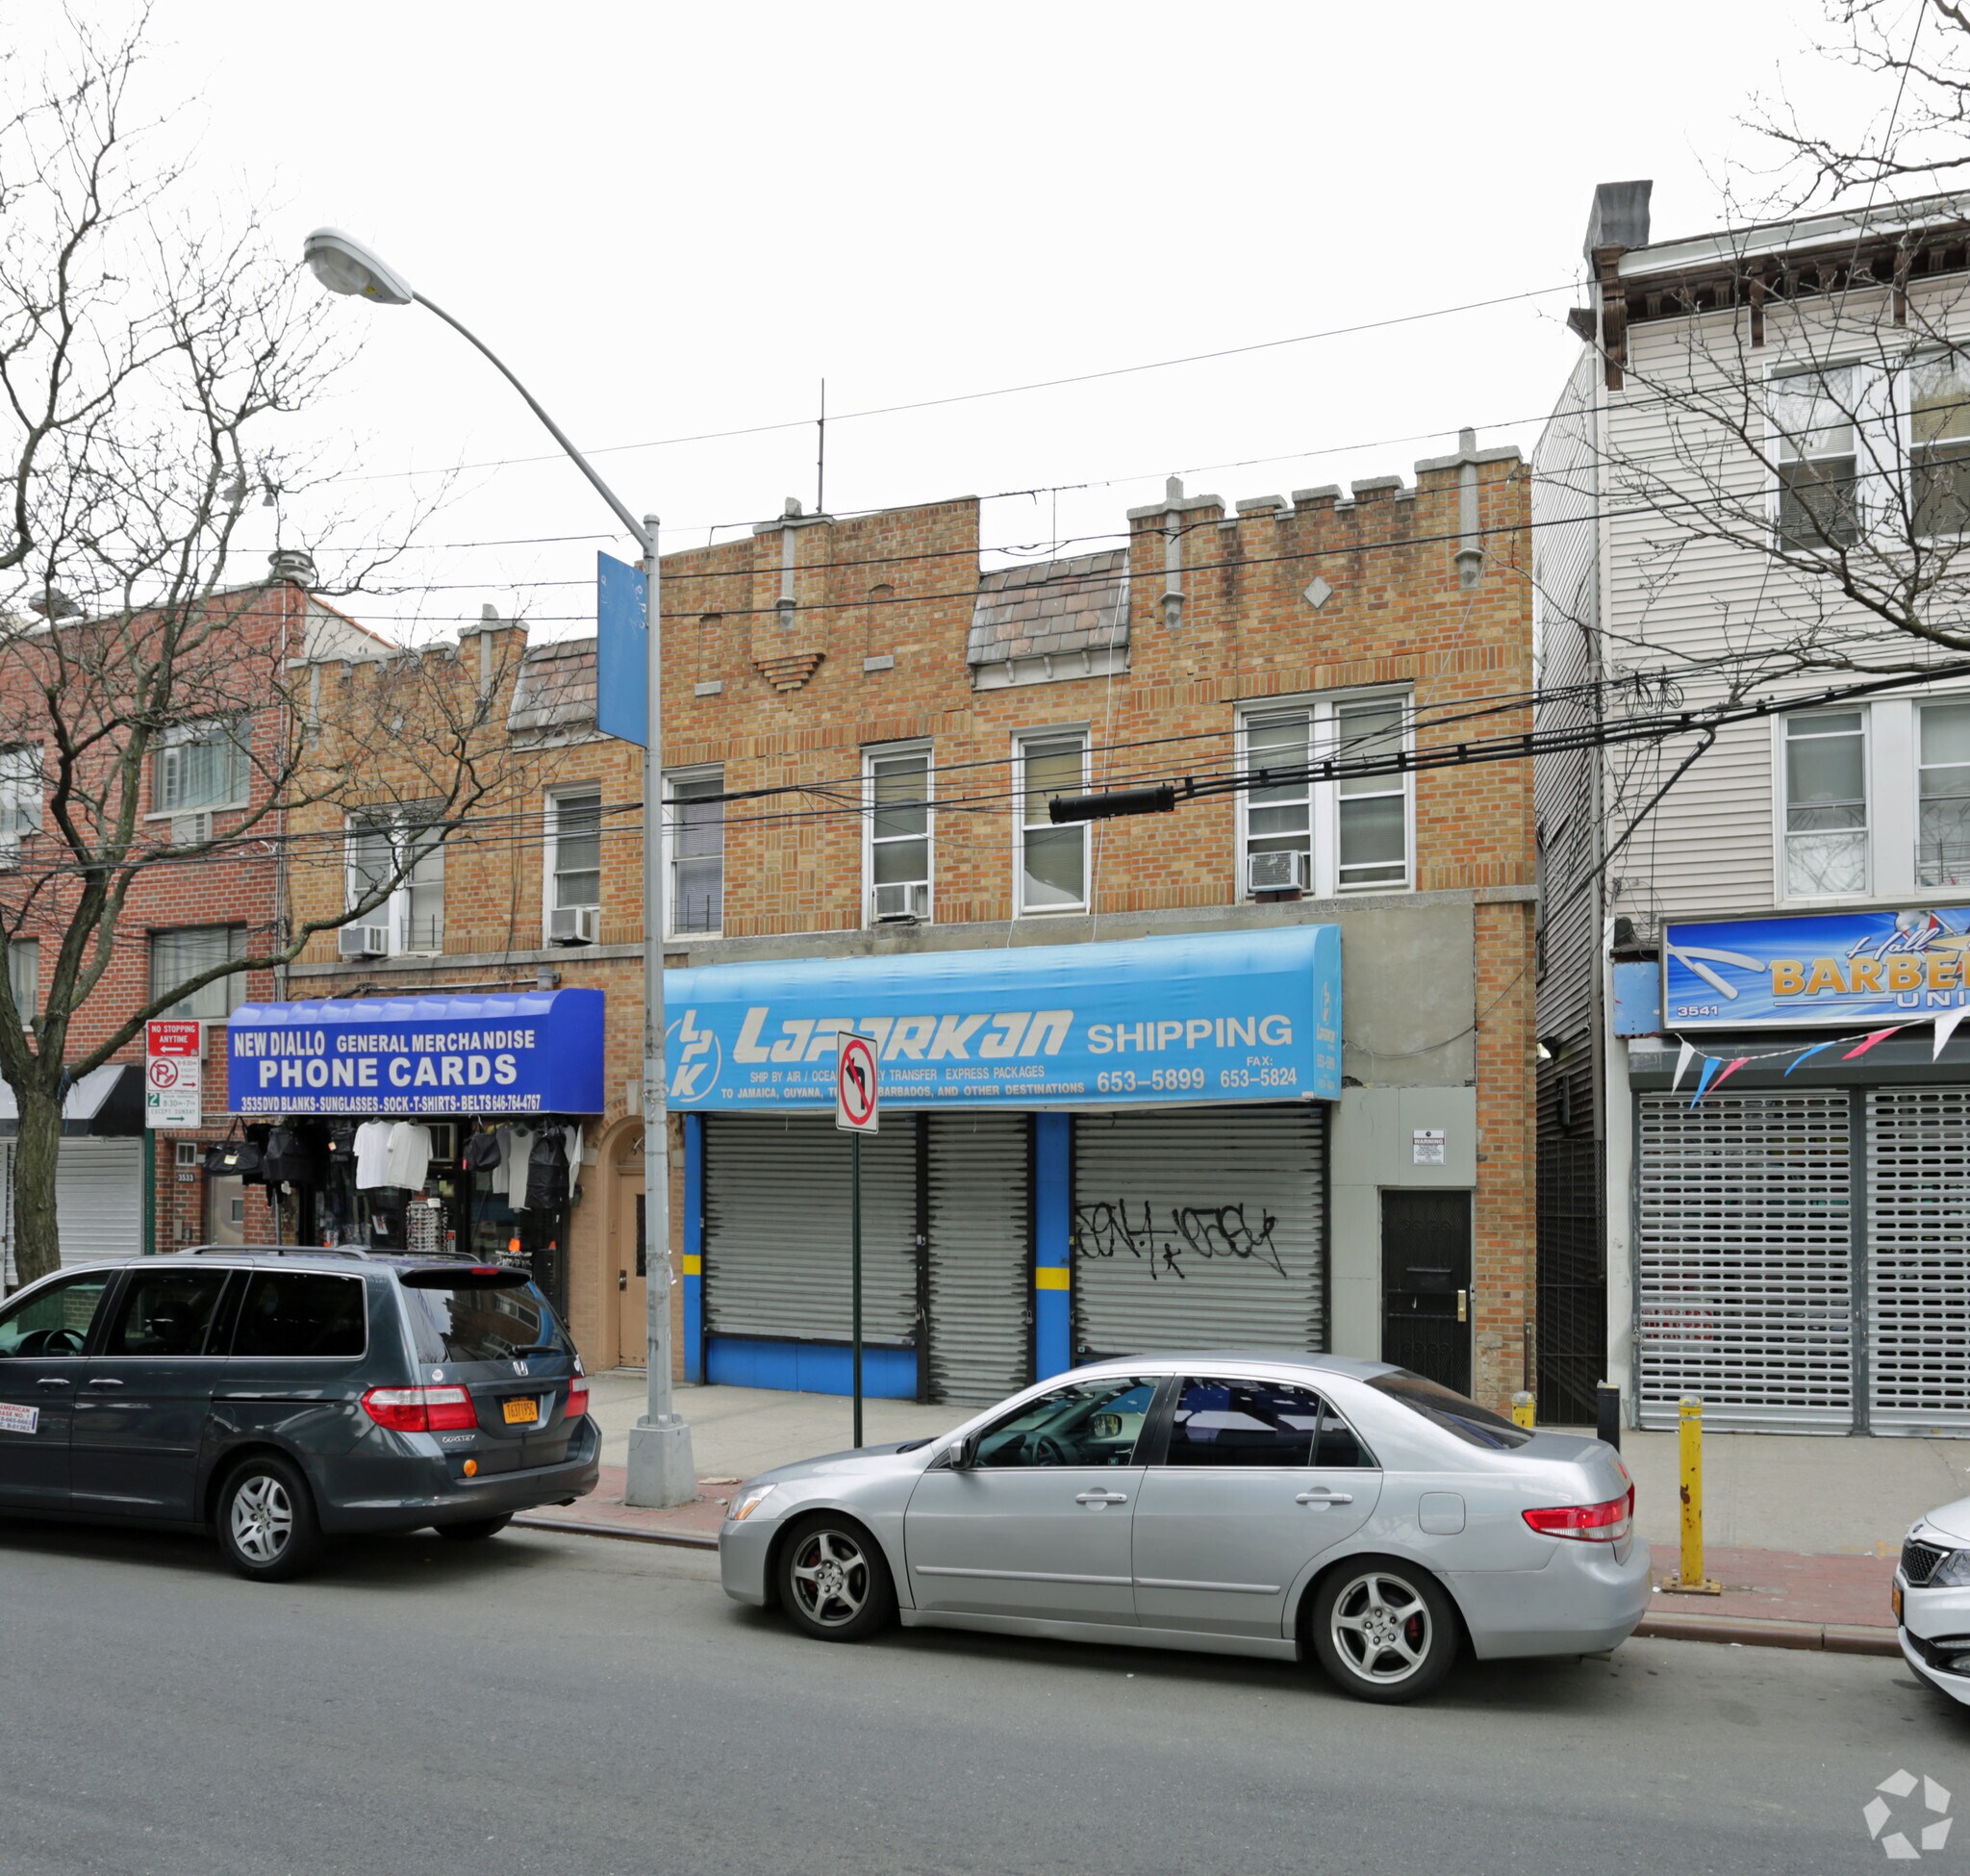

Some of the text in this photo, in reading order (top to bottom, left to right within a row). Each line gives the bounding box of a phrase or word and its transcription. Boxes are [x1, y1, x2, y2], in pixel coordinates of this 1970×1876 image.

[1846, 927, 1939, 961] Hall
[1769, 951, 1970, 997] BARBE
[1678, 1005, 1719, 1017] 3541
[151, 1025, 196, 1033] NO STOPPING
[1087, 1014, 1293, 1054] SHIPPING
[234, 1029, 536, 1057] NEW DIALLO GENERAL MERCHANDISE
[259, 1053, 518, 1088] PHONE CARDS
[1246, 1056, 1274, 1067] FAX:
[749, 1072, 769, 1083] SHIP
[771, 1072, 783, 1083] BY
[786, 1071, 801, 1082] AIR
[811, 1070, 838, 1082] OCEA
[889, 1068, 937, 1080] TRANSFER
[946, 1067, 989, 1079] EXPRESS
[993, 1065, 1045, 1078] PACKAGES
[1098, 1068, 1205, 1092] 653-5899
[1220, 1067, 1298, 1088] 653-5824
[149, 1093, 159, 1106] 2
[721, 1088, 734, 1099] TO
[738, 1088, 780, 1100] JAMAICA,
[783, 1087, 824, 1100] GUYANA,
[878, 1085, 935, 1098] BARBADOS,
[938, 1085, 959, 1097] AND
[964, 1084, 999, 1096] OTHER
[1005, 1082, 1085, 1095] DESTINATIONS
[240, 1097, 262, 1111] 3535
[263, 1097, 280, 1111] DVD
[461, 1095, 492, 1111] BELTS
[492, 1094, 542, 1110] 646-764-4767
